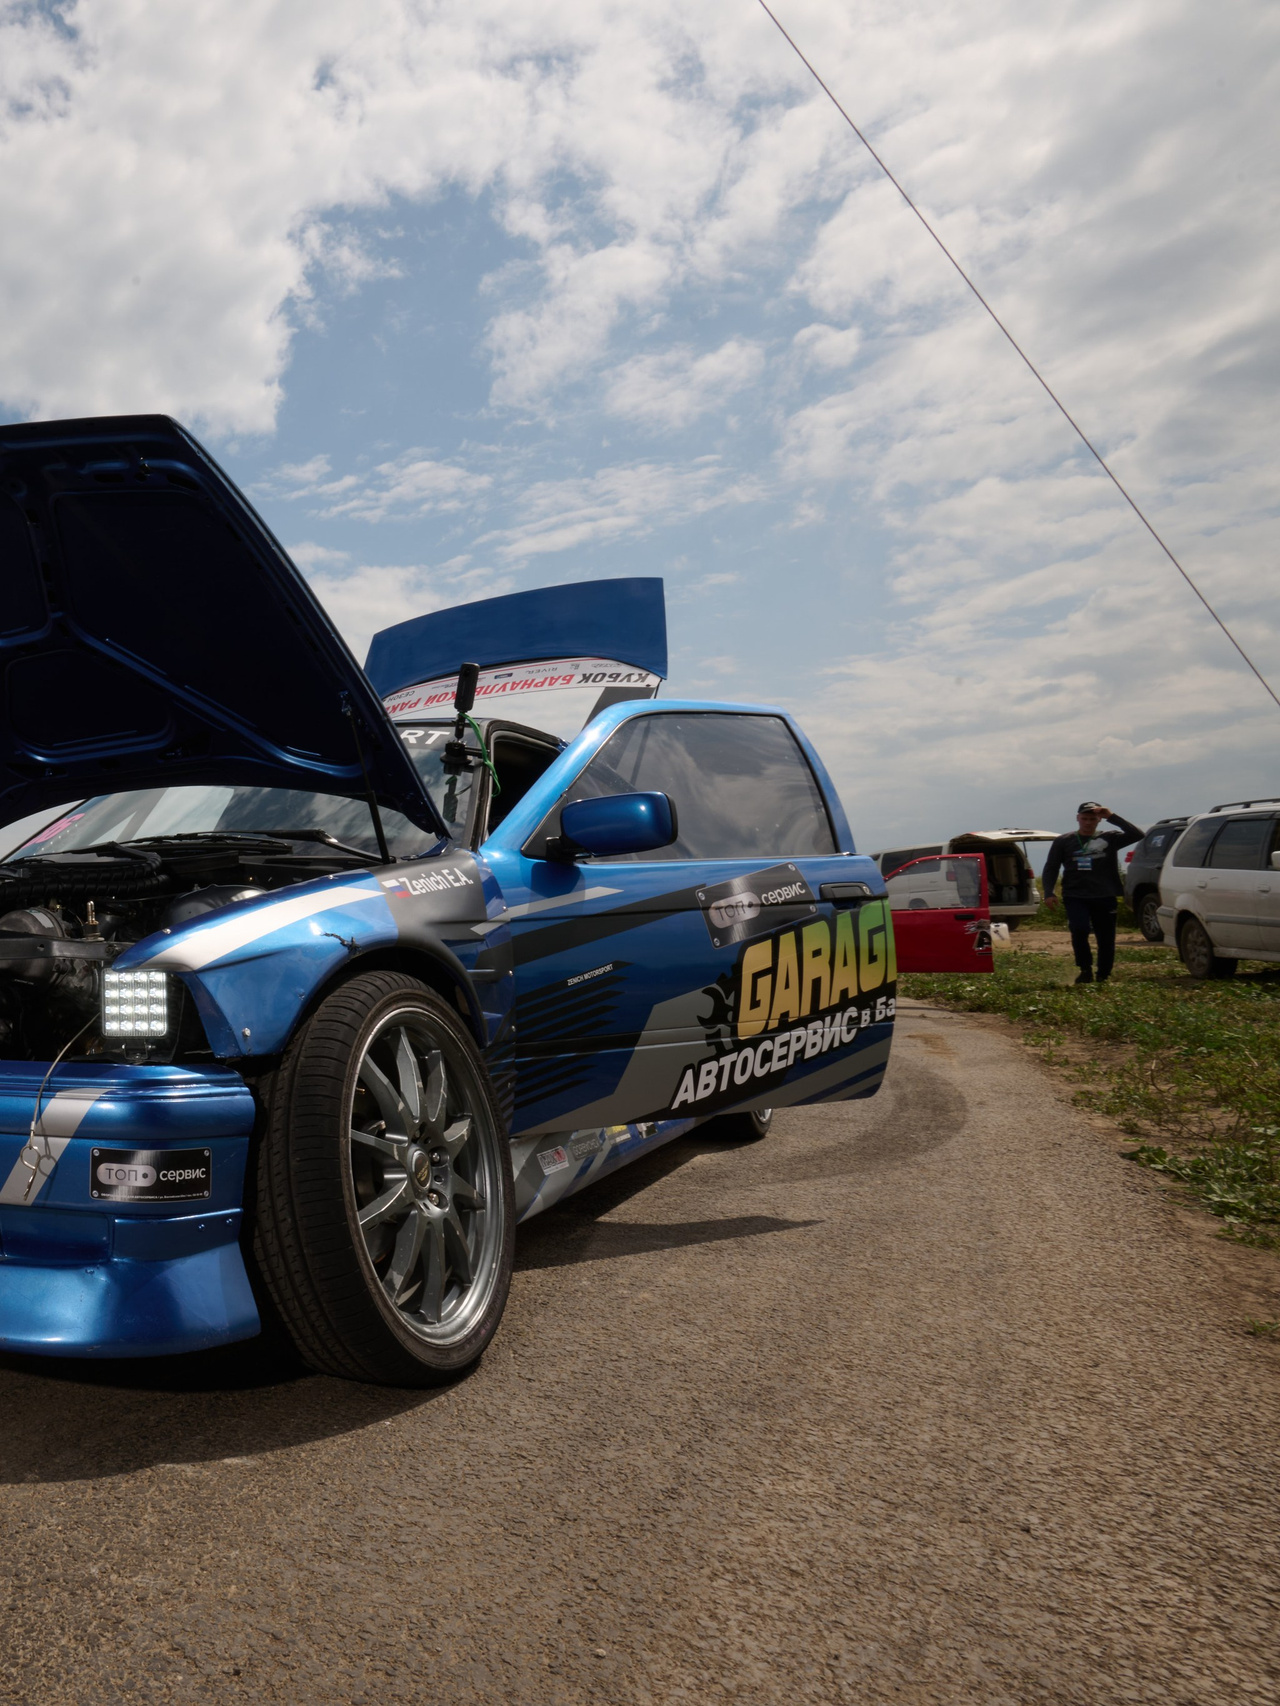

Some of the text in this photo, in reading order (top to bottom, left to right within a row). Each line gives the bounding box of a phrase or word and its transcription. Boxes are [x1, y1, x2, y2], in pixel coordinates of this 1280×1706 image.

[577, 672, 651, 684] КУБОК
[423, 673, 575, 707] БАРНАУЛЬКОЙ
[398, 867, 474, 896] Zenich E.A.
[761, 882, 806, 905] сервис
[584, 963, 614, 980] MOTORSPORT
[671, 1006, 858, 1110] АВТОСЕРВИС
[105, 1167, 206, 1182] ТОП сервис
